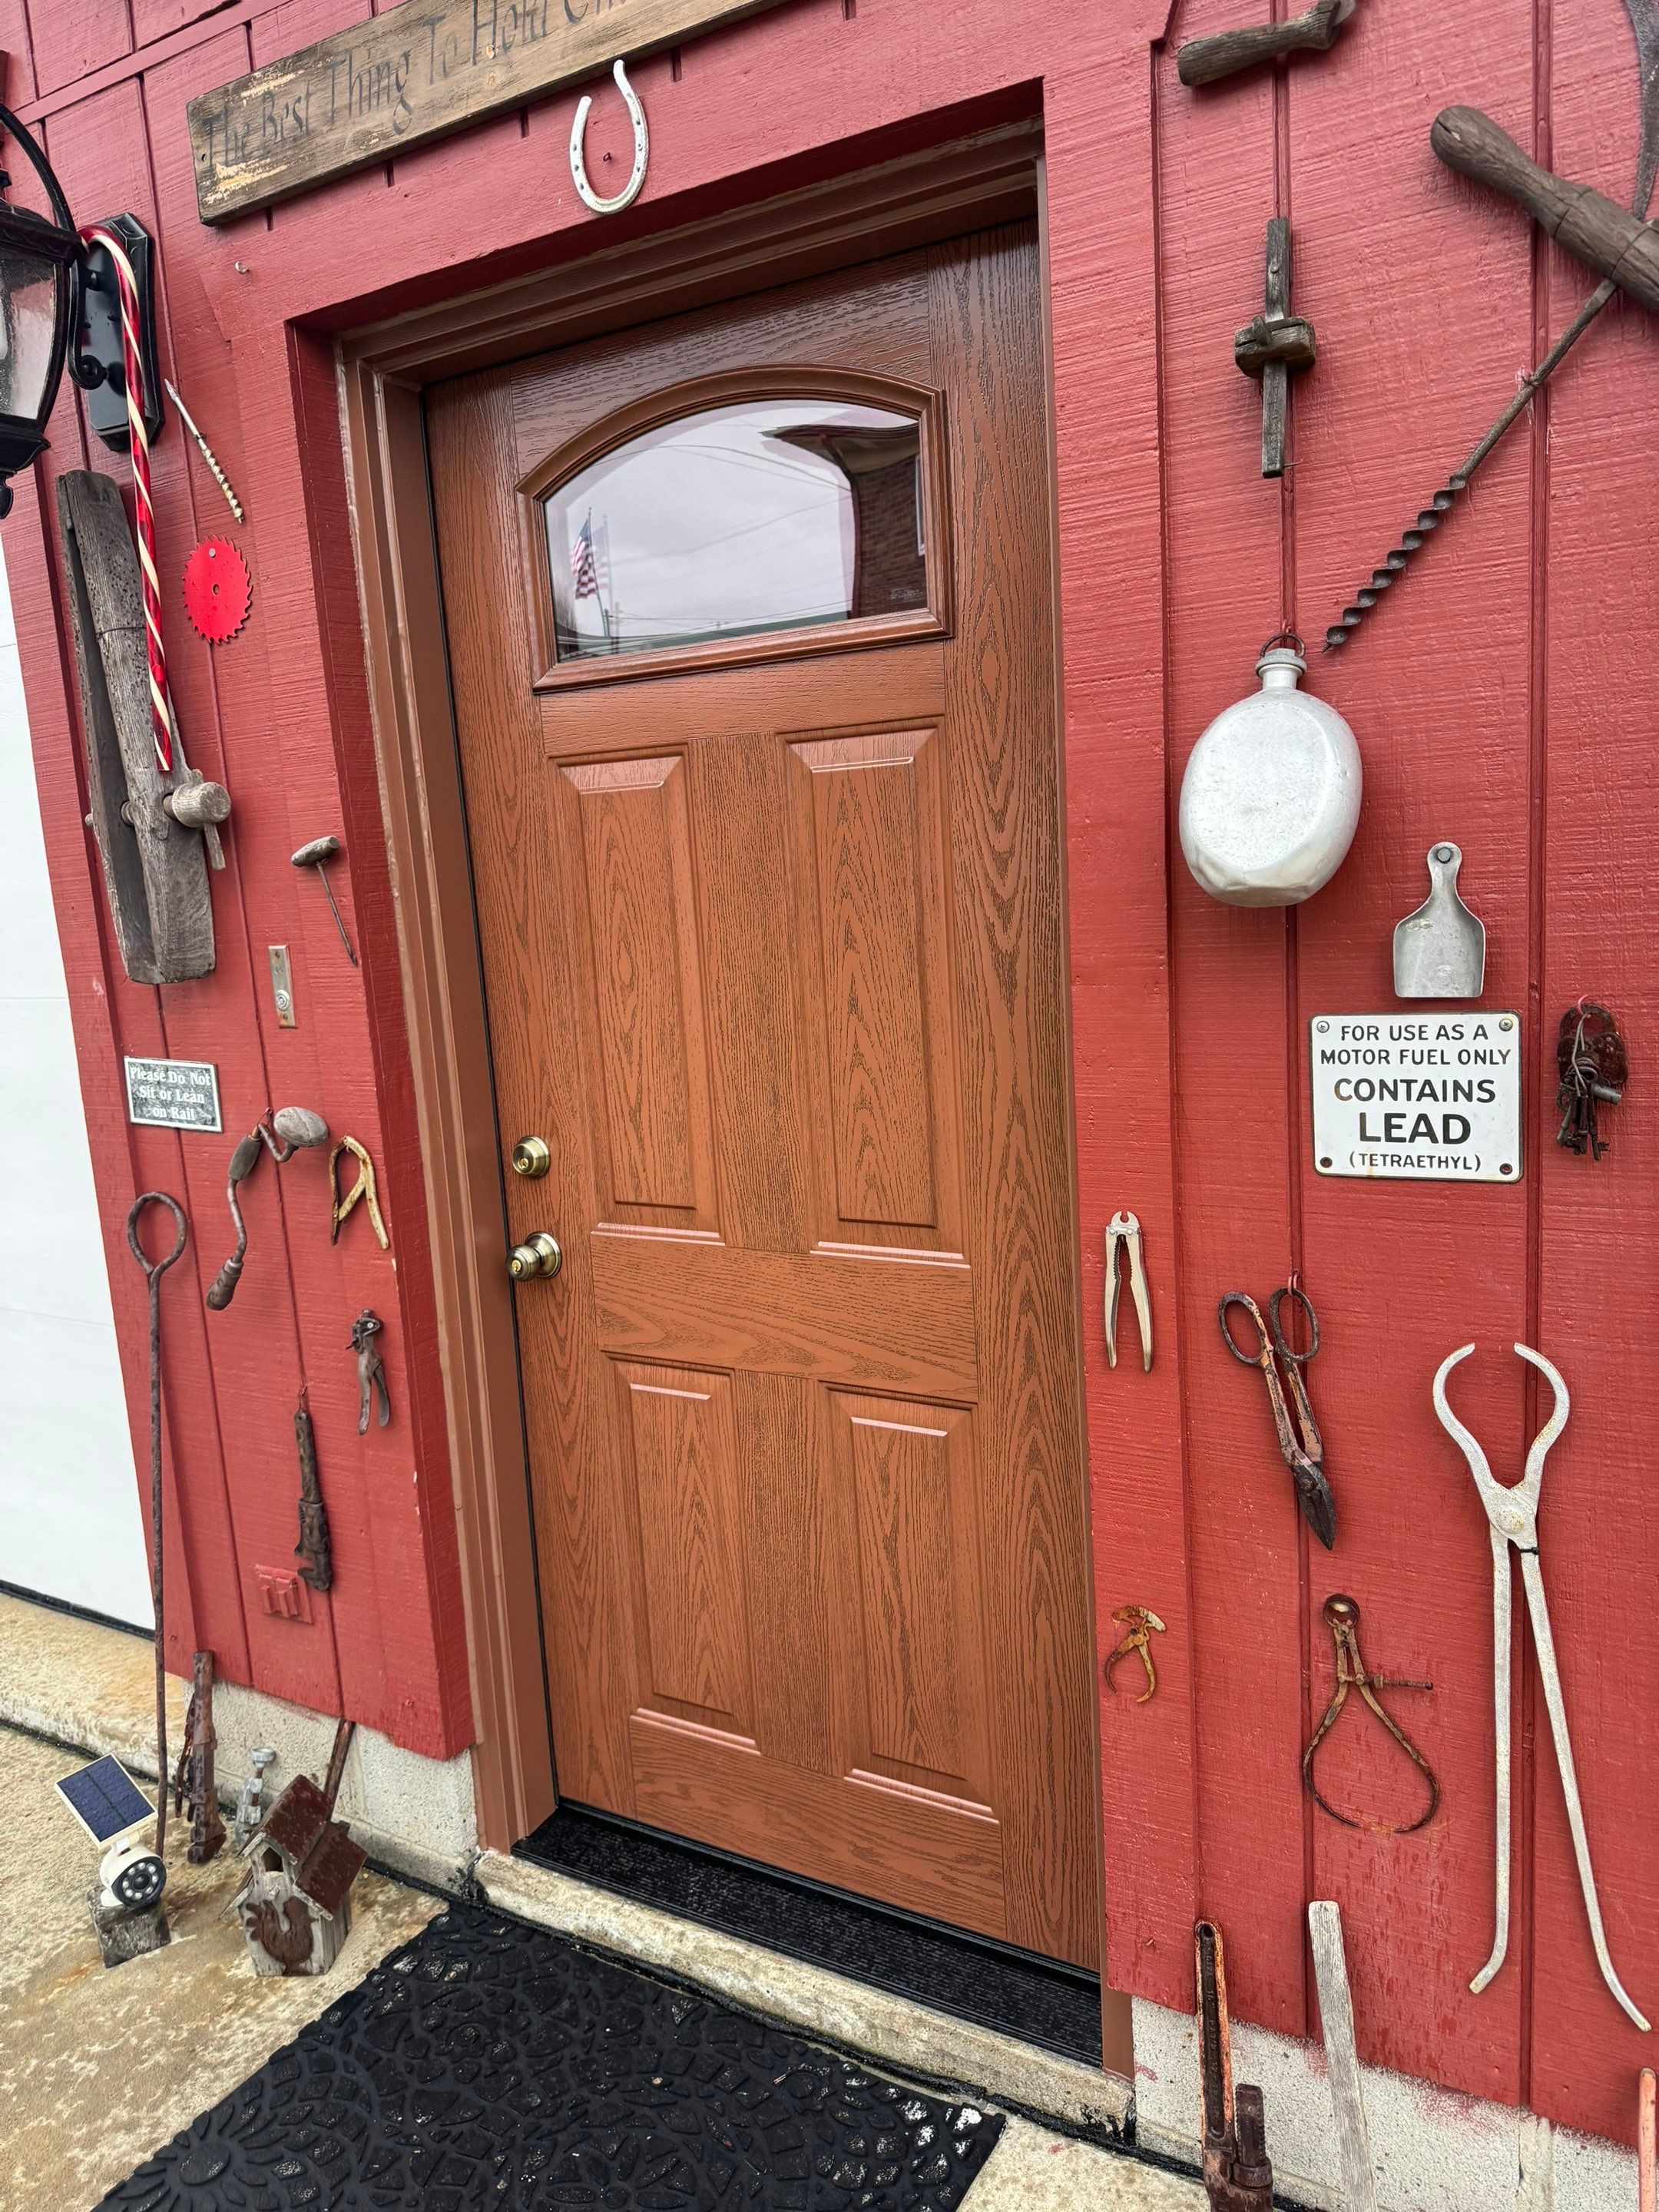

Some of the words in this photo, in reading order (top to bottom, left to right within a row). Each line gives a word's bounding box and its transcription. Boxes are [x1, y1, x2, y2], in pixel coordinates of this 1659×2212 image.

[324, 48, 413, 136] Thing
[422, 14, 459, 86] To
[1341, 1025, 1380, 1041] FOR
[1389, 1024, 1429, 1041] USE
[1435, 1024, 1465, 1041] AS
[1472, 1024, 1488, 1041] A
[1320, 1048, 1391, 1065] MOTOR
[1399, 1048, 1451, 1065] FUEL
[1457, 1048, 1512, 1065] ONLY
[129, 1066, 167, 1082] Please
[168, 1071, 186, 1084] Do
[189, 1071, 212, 1087] Not
[138, 1084, 157, 1099] Sit
[159, 1089, 173, 1101] or
[175, 1088, 206, 1104] Lean
[1333, 1078, 1496, 1104] CONTAINS
[152, 1107, 168, 1118] on
[171, 1106, 197, 1121] Rail
[1359, 1112, 1472, 1145] LEAD
[1349, 1151, 1482, 1173] (TETRAETHYL)
